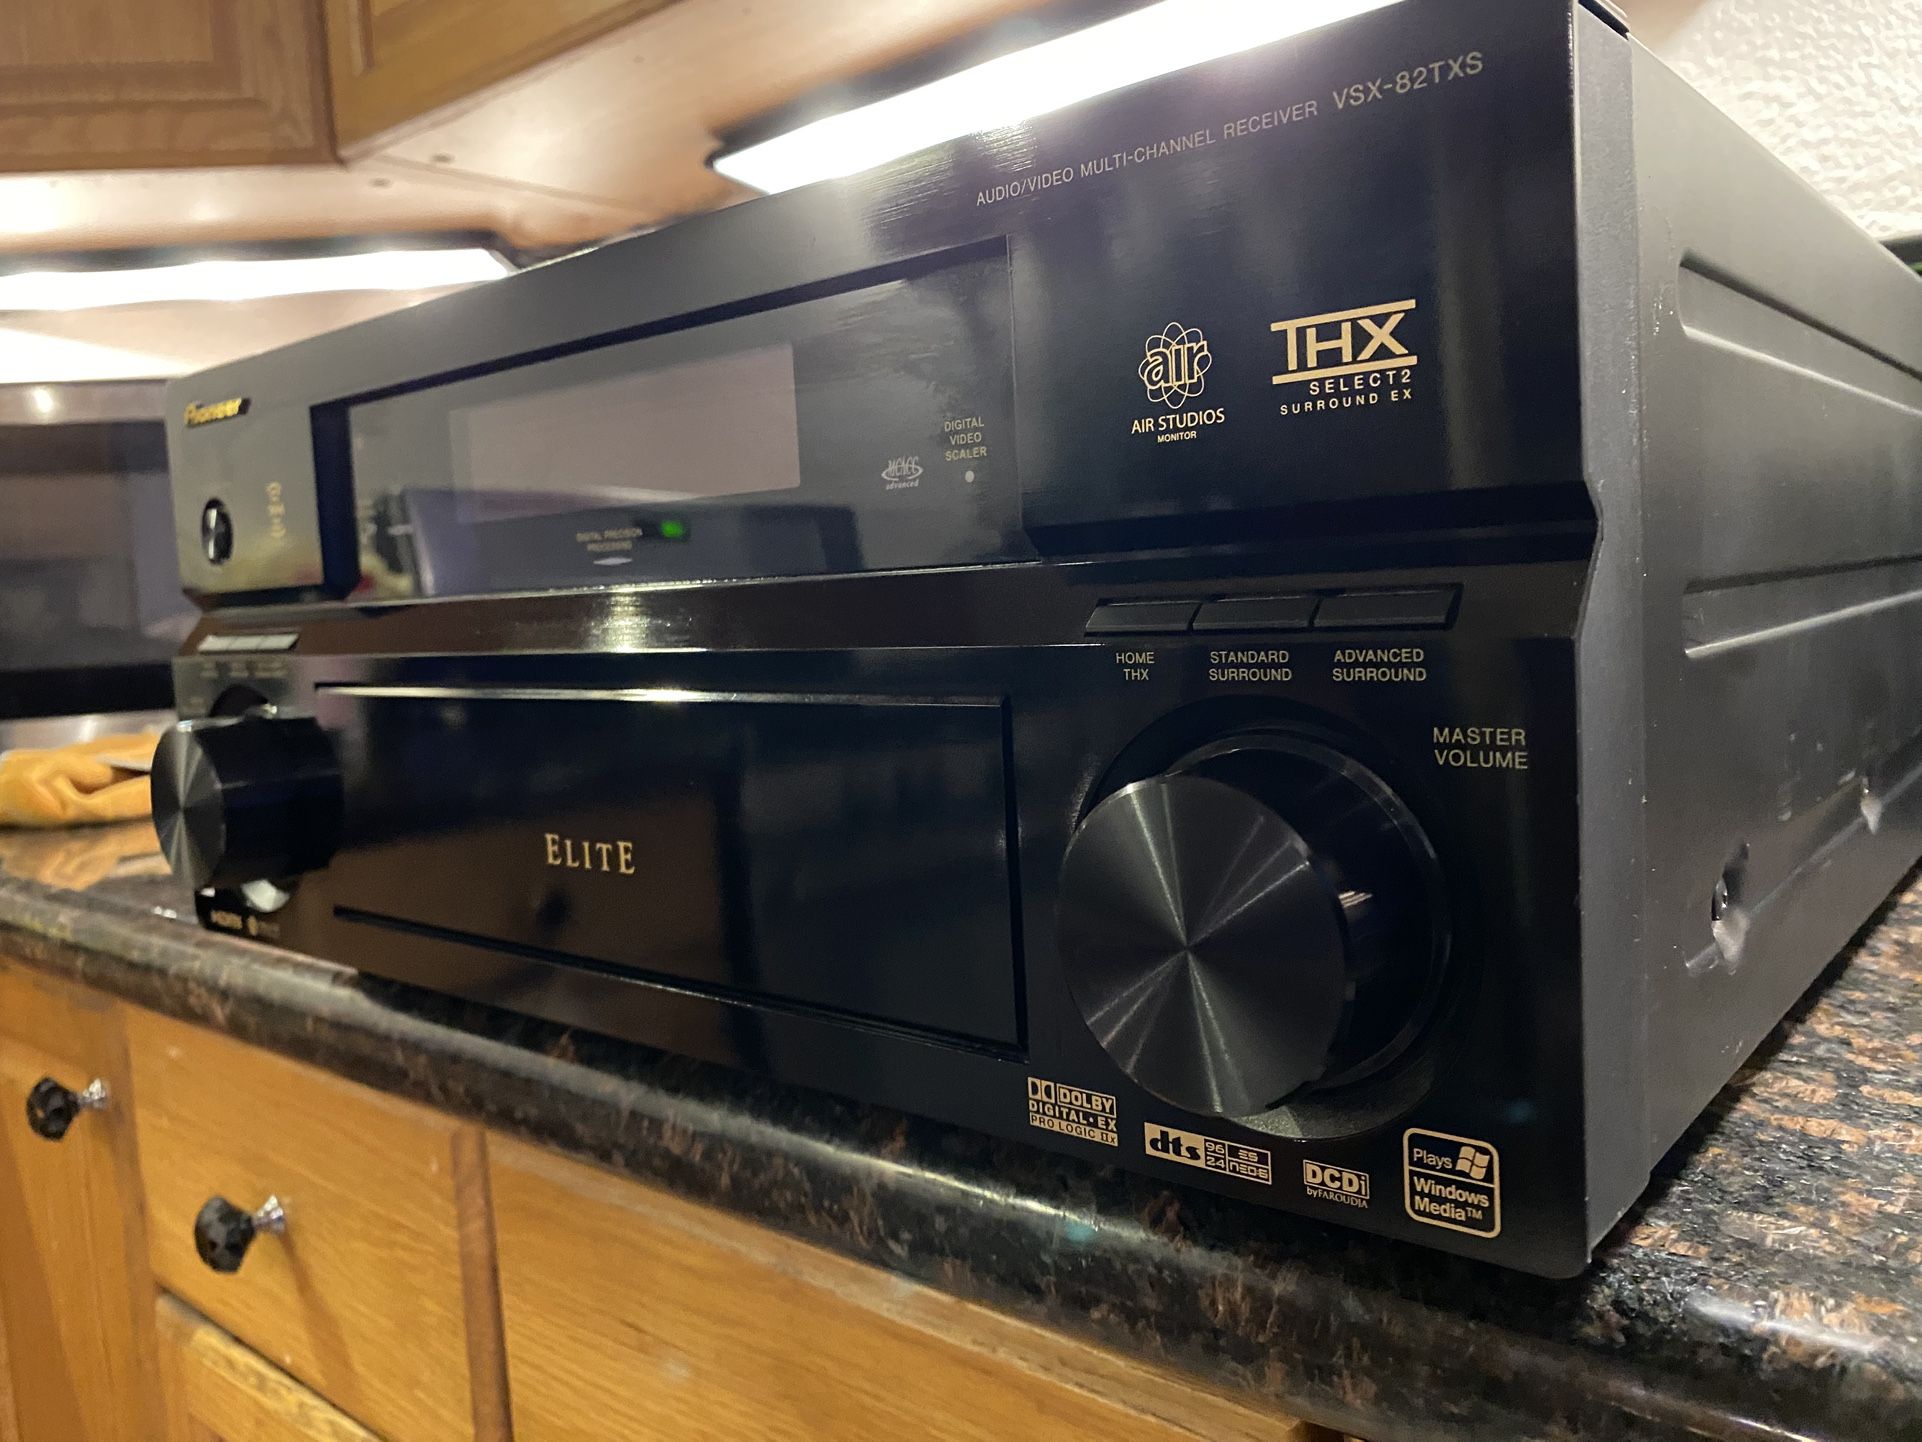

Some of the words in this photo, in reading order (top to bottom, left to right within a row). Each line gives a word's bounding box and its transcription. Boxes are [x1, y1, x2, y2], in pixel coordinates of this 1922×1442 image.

[976, 167, 1074, 206] AUDIO/VIDEO
[1080, 129, 1216, 179] MULTI-CHANNEL
[1223, 100, 1318, 140] RECEIVER
[1333, 51, 1484, 110] VSX-82TXS
[1270, 299, 1417, 371] THX
[1144, 340, 1208, 390] air
[1309, 369, 1412, 396] SELECT2
[1280, 393, 1379, 415] SURROUND
[1391, 389, 1413, 402] EX
[944, 416, 985, 432] DIGITAL
[1131, 417, 1155, 435] AIR
[1158, 407, 1226, 431] STUDIOS
[949, 432, 982, 445] VIDEO
[1157, 430, 1197, 443] MONITOR
[945, 446, 987, 461] SCALER
[1115, 651, 1155, 665] HOME
[1209, 650, 1289, 664] STANDARD
[1333, 648, 1425, 663] ADVANCED
[1123, 668, 1149, 681] THX
[1208, 668, 1292, 682] SURROUND
[1332, 667, 1427, 682] SURROUND
[1432, 726, 1527, 747] MASTER
[1434, 749, 1529, 770] VOLUME
[544, 833, 635, 874] ELITE
[1059, 1087, 1113, 1113] DOLBY
[1031, 1115, 1054, 1129] PRO
[1058, 1121, 1096, 1139] LOGIC
[1149, 1130, 1201, 1161] dts
[1205, 1142, 1225, 1154] 96
[1206, 1156, 1226, 1168] 24
[1413, 1147, 1453, 1169] Plays
[1304, 1163, 1367, 1196] DCDi
[1413, 1176, 1490, 1207] Windows
